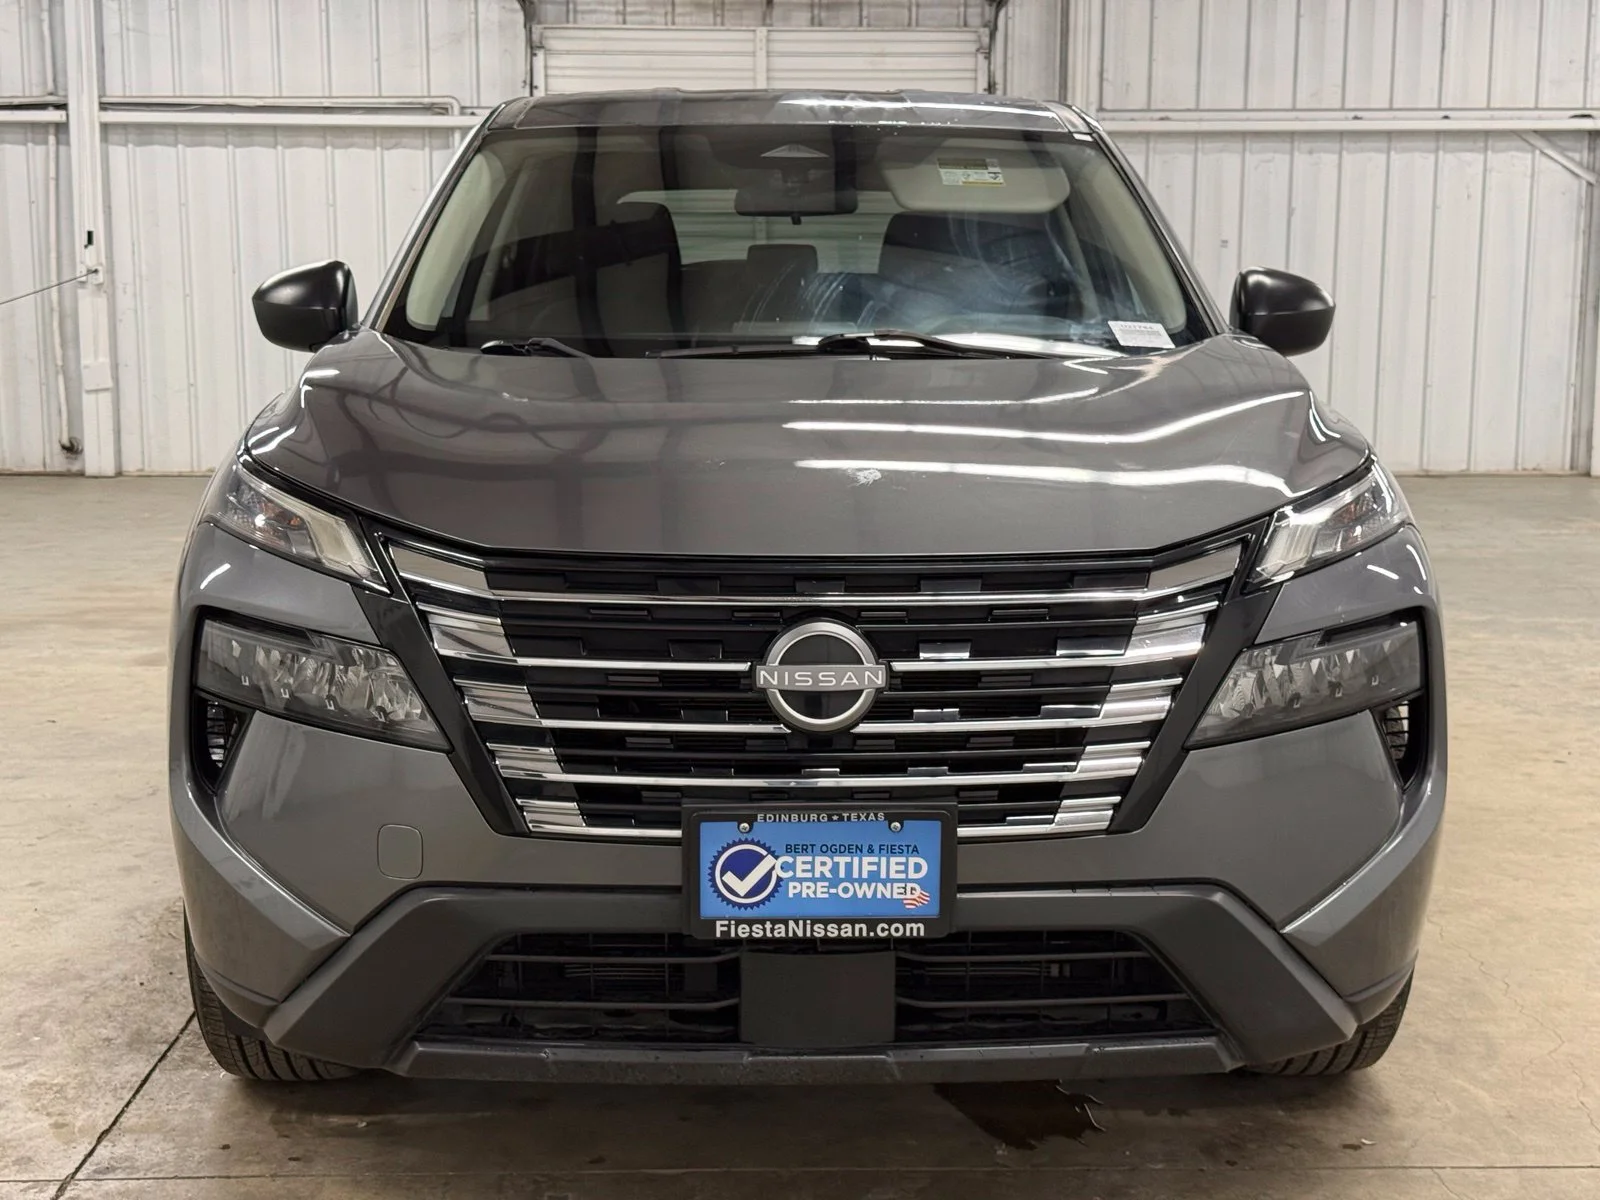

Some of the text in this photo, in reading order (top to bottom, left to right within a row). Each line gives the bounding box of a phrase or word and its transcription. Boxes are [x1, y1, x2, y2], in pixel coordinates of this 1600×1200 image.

[760, 670, 882, 686] NISSAN
[757, 812, 885, 823] EDINBURG TEXAS
[785, 844, 919, 855] BERT OGDEN & FIESTA
[774, 856, 929, 879] CERTIFIED
[788, 882, 921, 899] PRE-OWNED
[715, 920, 925, 938] FiestaNissan.com
